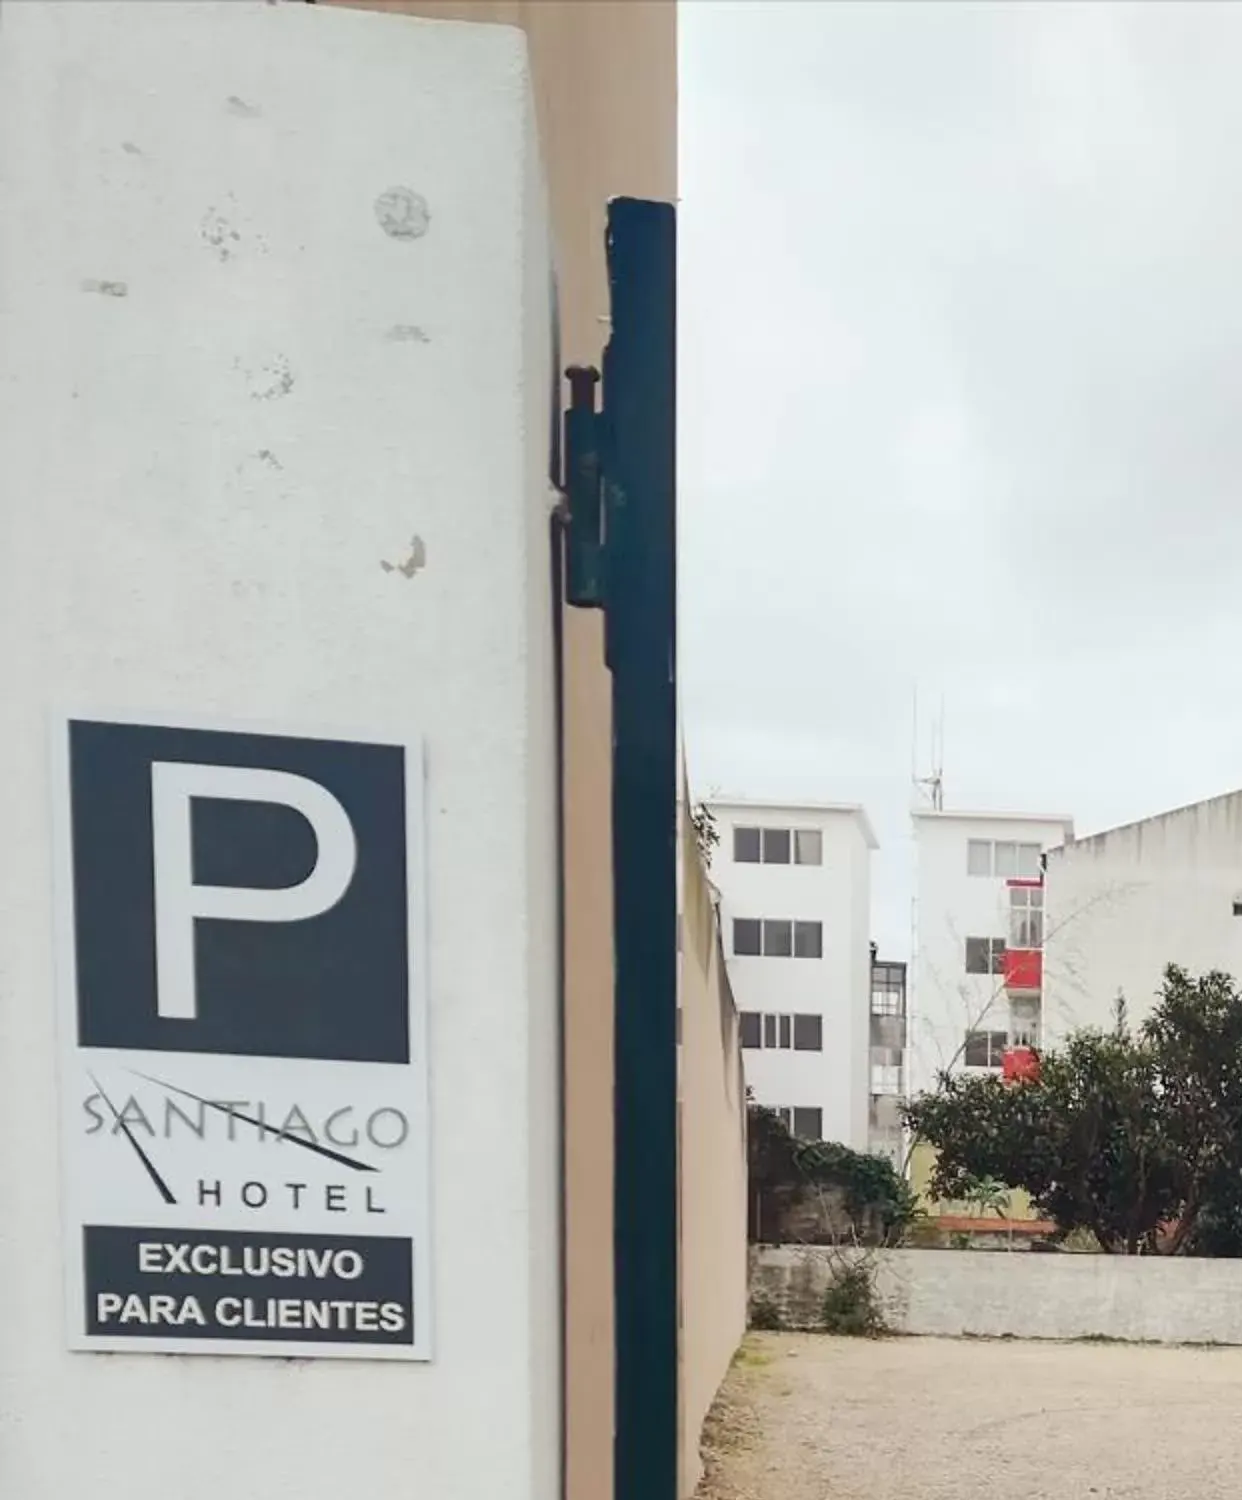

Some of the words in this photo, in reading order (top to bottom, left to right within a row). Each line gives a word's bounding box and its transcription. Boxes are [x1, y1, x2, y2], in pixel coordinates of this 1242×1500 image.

[151, 761, 357, 1019] P
[83, 1094, 409, 1149] SANTIAGO
[198, 1179, 386, 1213] HOTEL
[138, 1242, 363, 1279] EXCLUSIVO
[97, 1292, 205, 1325] PARA
[214, 1297, 406, 1332] CLIENTES
